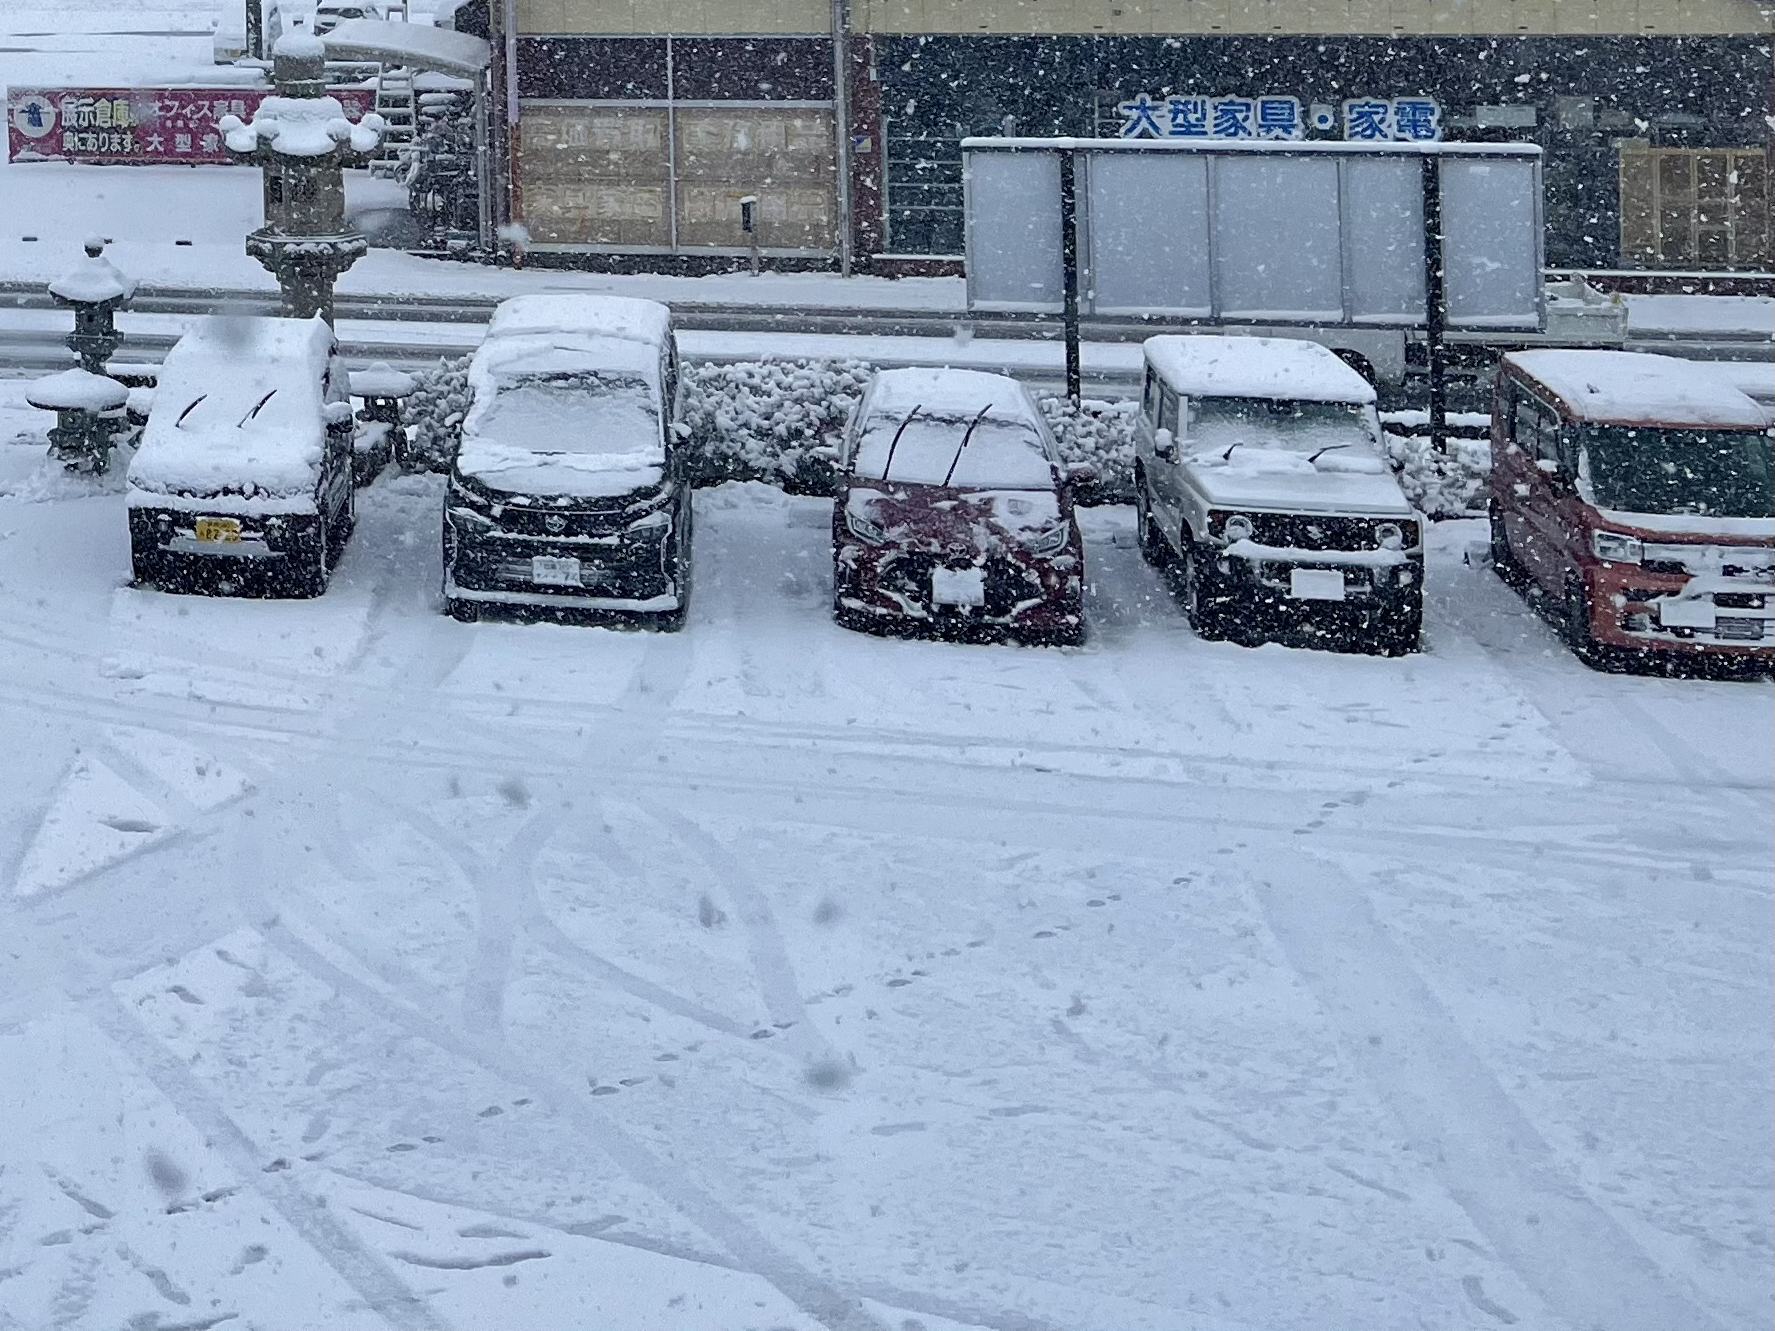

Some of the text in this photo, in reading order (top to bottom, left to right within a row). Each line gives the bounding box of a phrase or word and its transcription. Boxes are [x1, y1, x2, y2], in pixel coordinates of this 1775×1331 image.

[1120, 94, 1440, 140] 大型家具・家電
